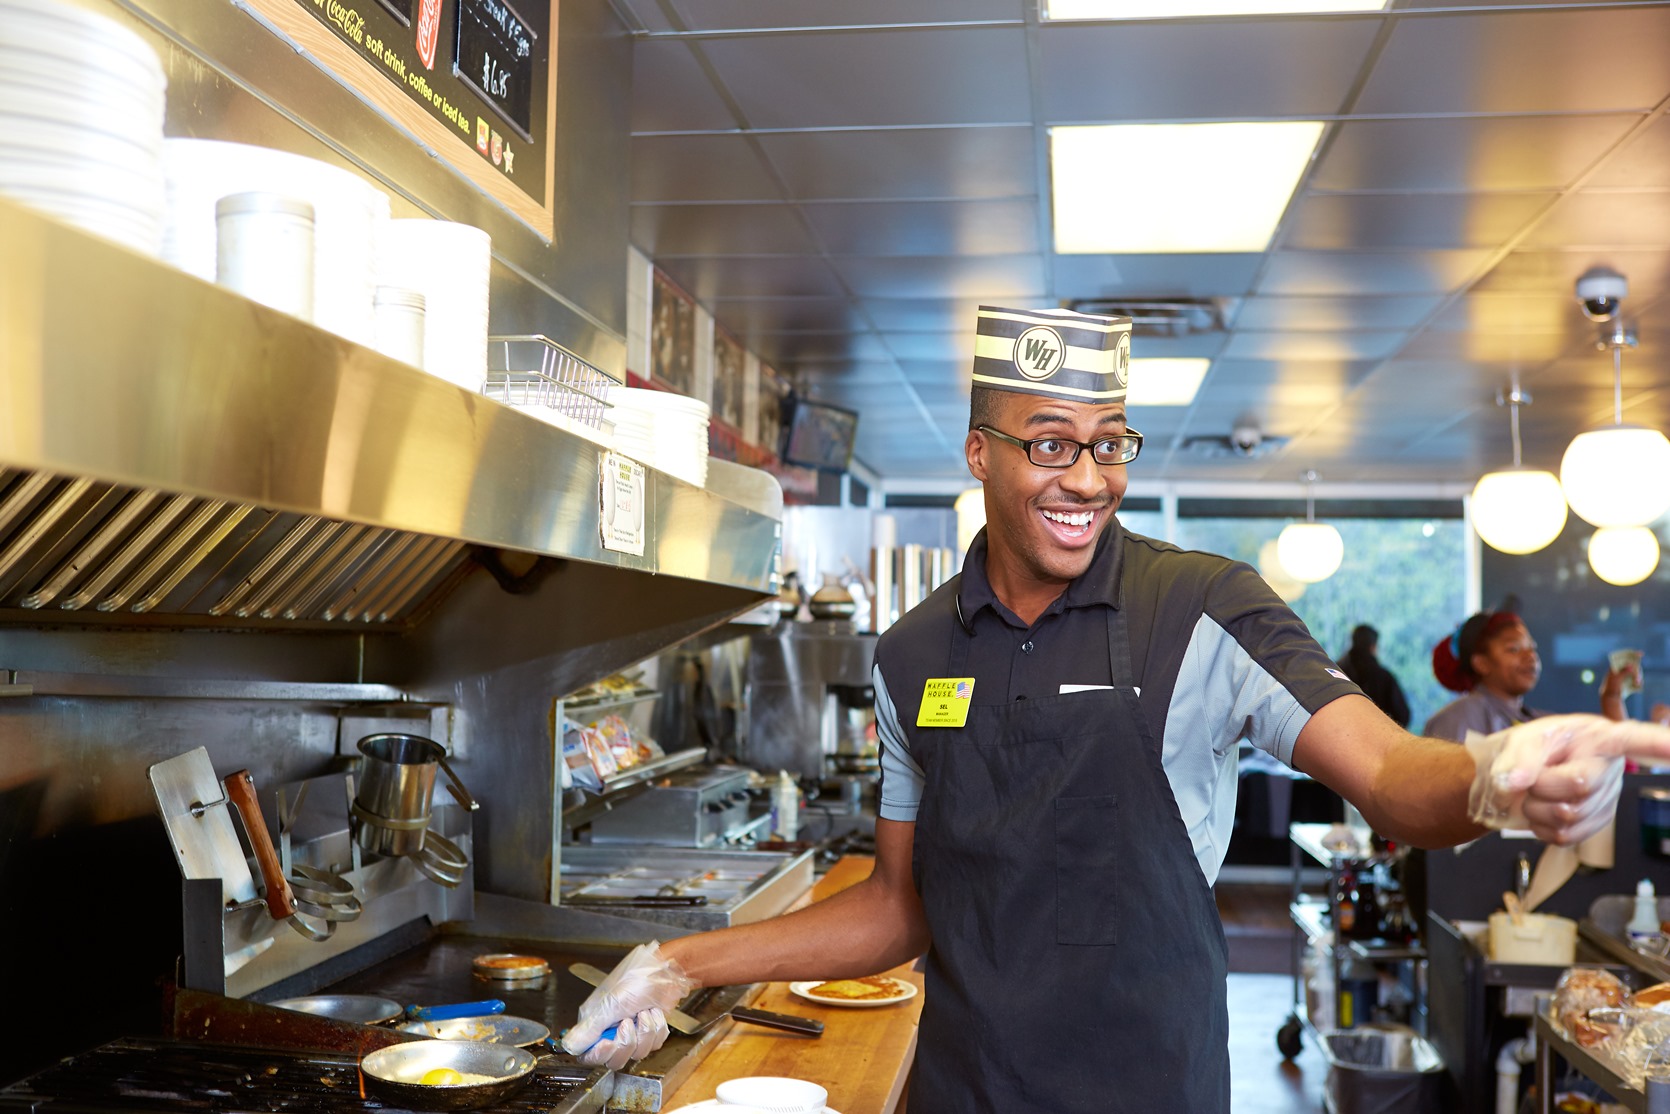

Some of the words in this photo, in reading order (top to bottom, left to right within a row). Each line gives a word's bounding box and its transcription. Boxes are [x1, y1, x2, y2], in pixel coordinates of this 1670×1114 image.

[365, 34, 384, 60] soft
[384, 48, 407, 84] drink,
[408, 72, 433, 101] coffee
[433, 93, 443, 109] or
[442, 97, 458, 123] iced
[457, 112, 471, 135] tea.
[1024, 338, 1058, 371] WH
[927, 682, 957, 690] WAFFLE
